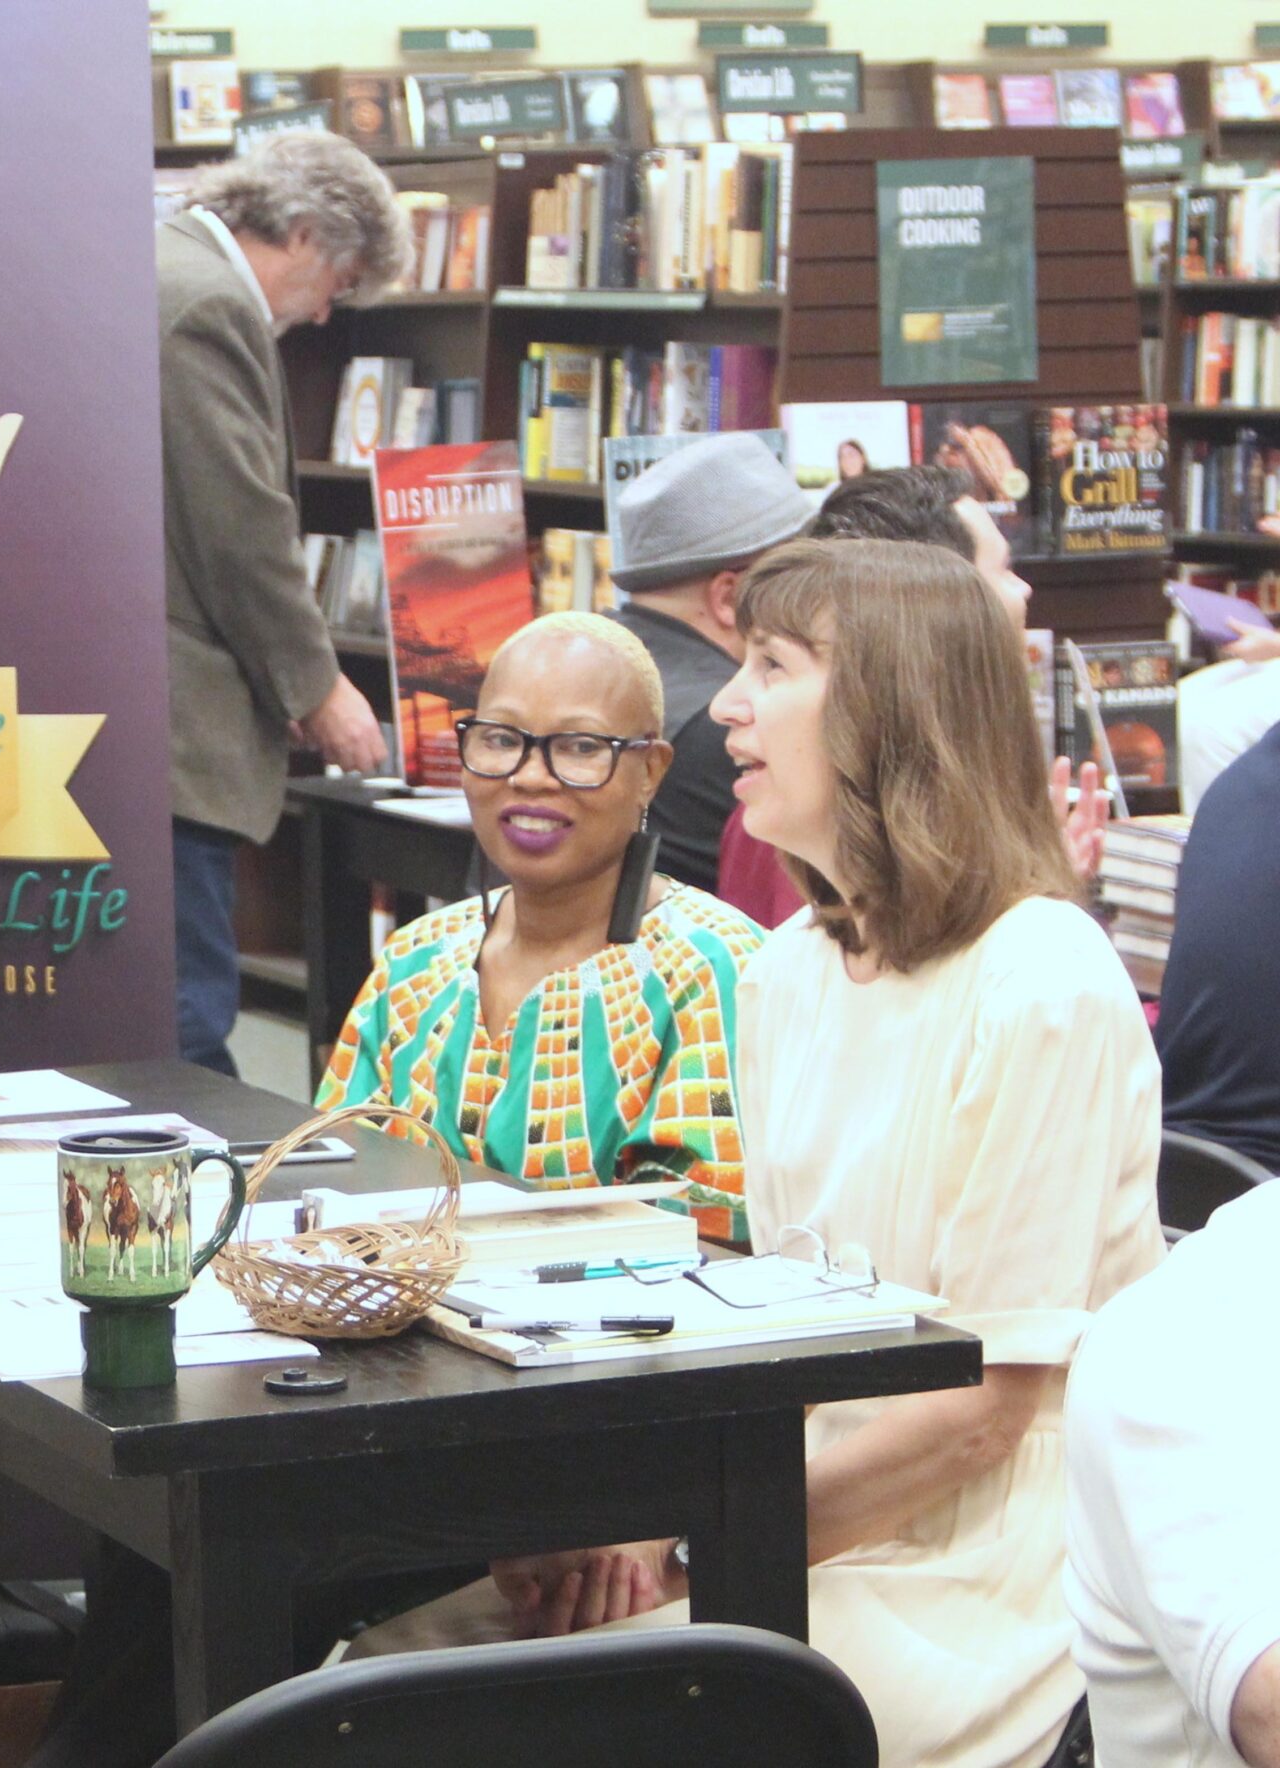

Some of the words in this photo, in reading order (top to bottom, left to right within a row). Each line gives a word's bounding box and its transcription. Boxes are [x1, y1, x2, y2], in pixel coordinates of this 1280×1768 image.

[898, 185, 986, 216] OUTDOOR
[899, 217, 982, 247] COOKING
[1073, 439, 1135, 472] How
[385, 482, 514, 521] DISRUPTION
[1059, 466, 1138, 506] Grill
